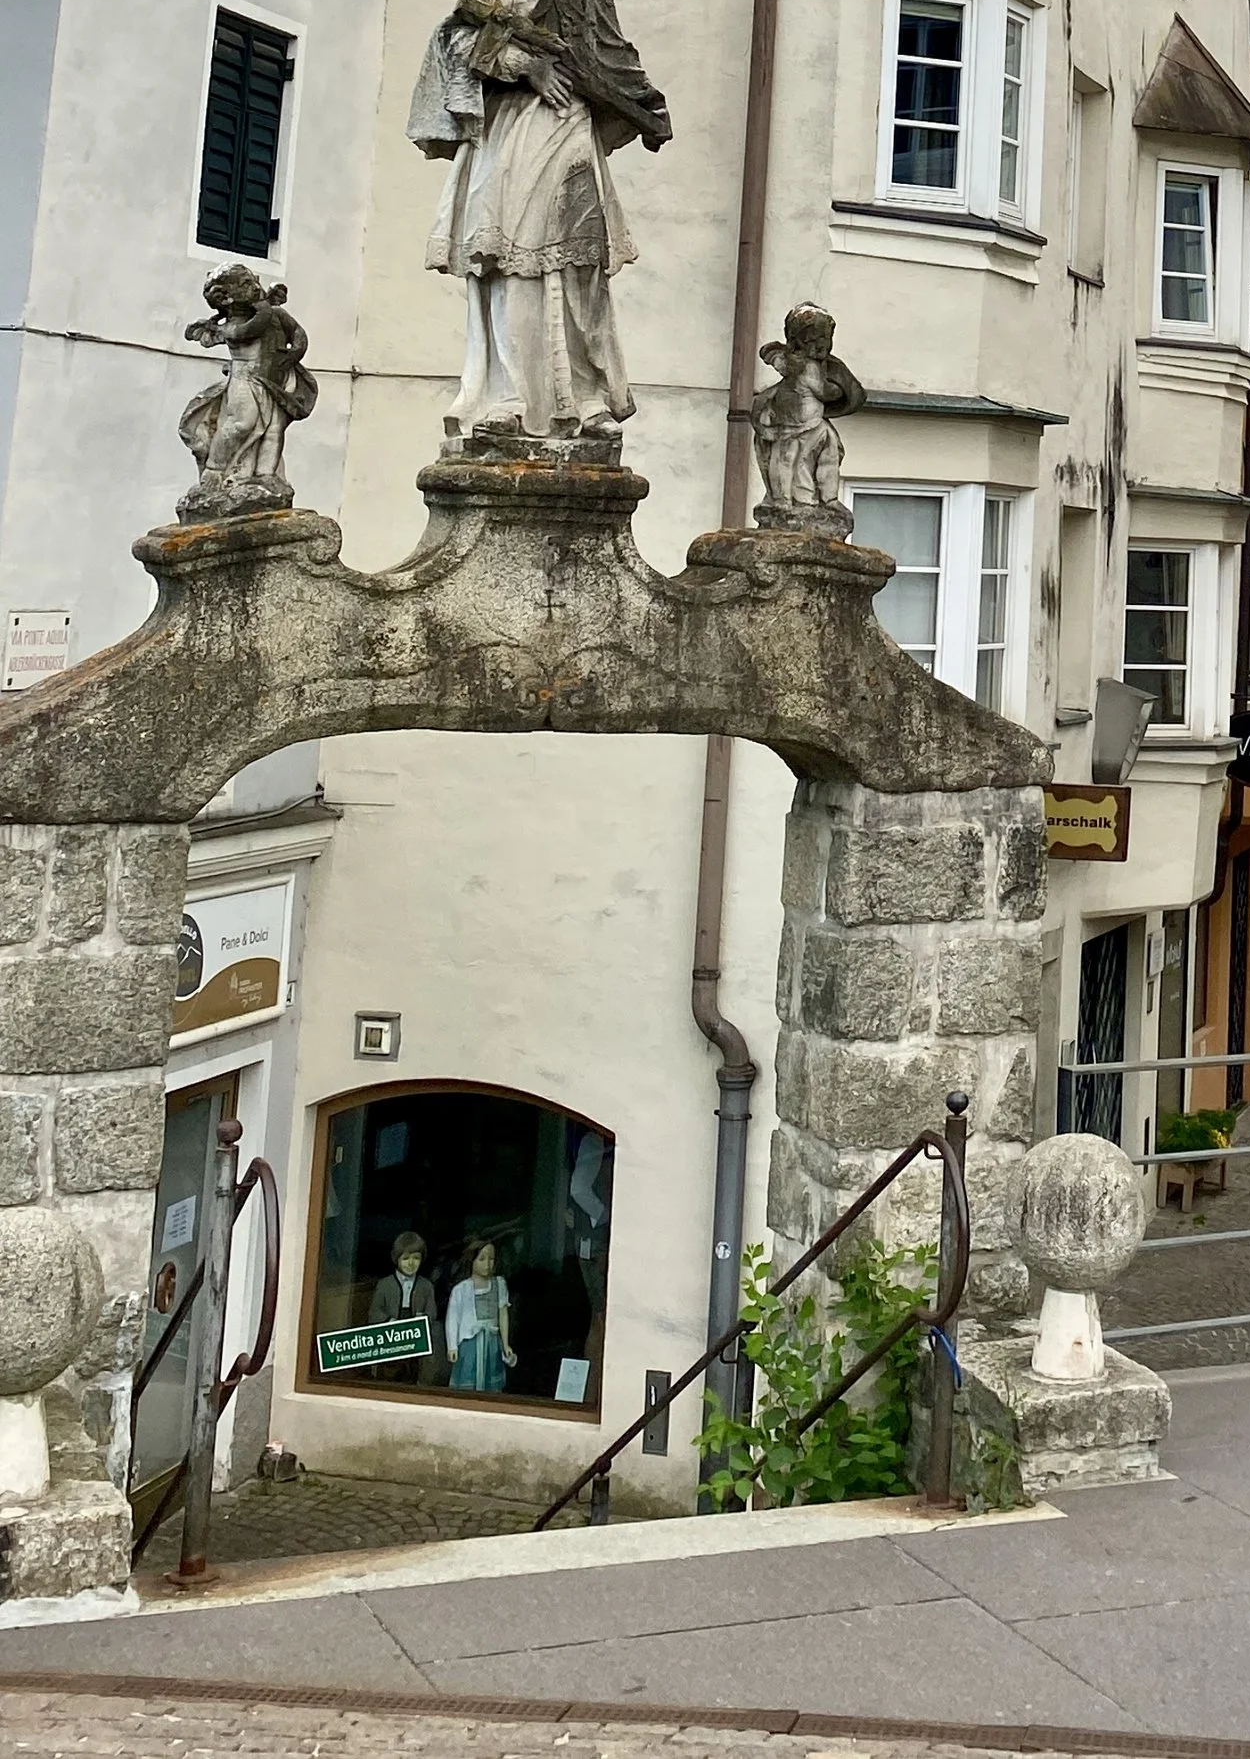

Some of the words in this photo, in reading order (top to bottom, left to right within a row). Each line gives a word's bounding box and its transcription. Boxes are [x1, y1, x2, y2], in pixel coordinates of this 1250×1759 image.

[1046, 815, 1112, 829] arschalk
[220, 936, 240, 951] Pane
[242, 932, 248, 946] &
[249, 930, 269, 944] Dolci
[327, 1334, 374, 1353] Vendita
[377, 1335, 384, 1344] a
[385, 1328, 421, 1343] Varna
[341, 1354, 351, 1362] km
